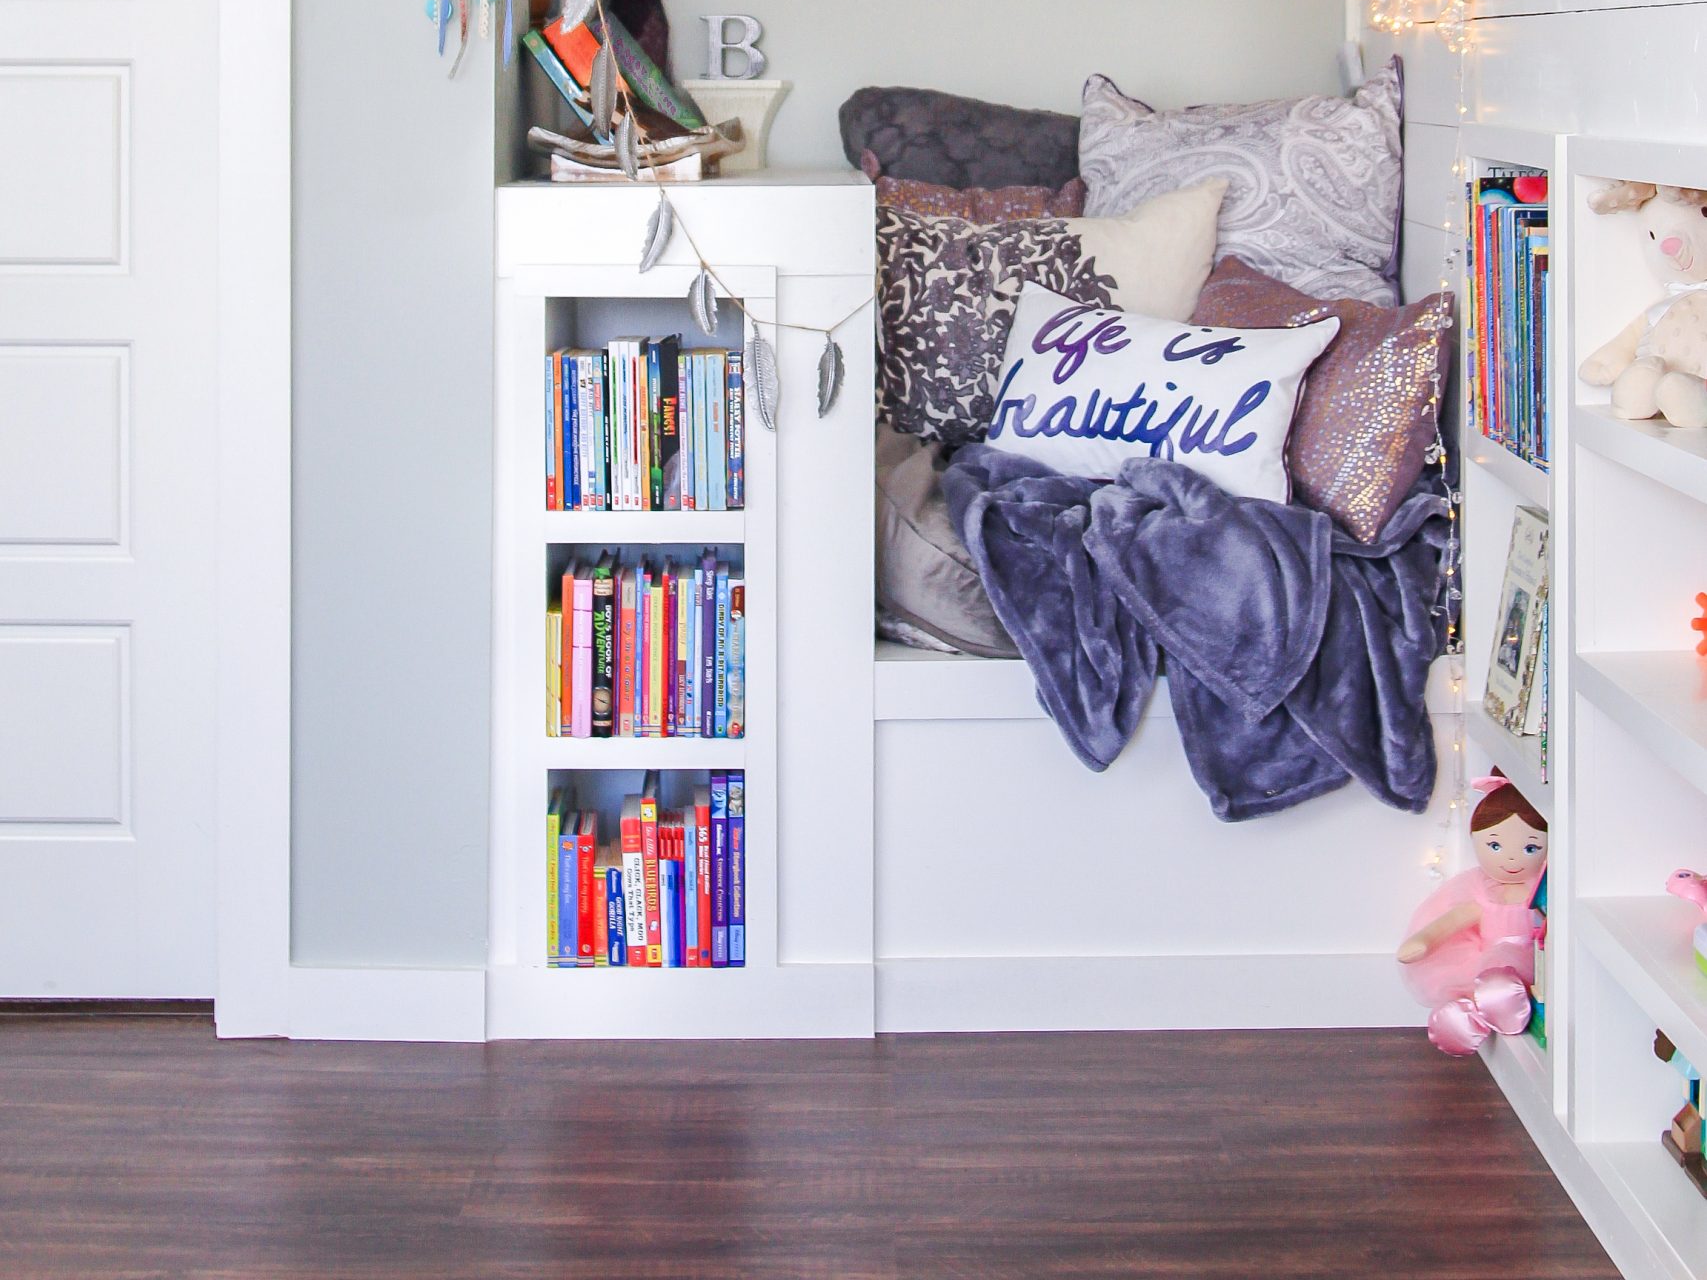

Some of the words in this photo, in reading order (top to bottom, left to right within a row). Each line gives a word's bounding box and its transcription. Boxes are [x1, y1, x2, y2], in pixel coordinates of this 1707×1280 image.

[700, 14, 767, 80] B
[1032, 304, 1132, 385] life
[1164, 328, 1246, 365] is
[662, 397, 678, 436] FANGS!
[987, 358, 1272, 462] beautiful
[594, 611, 608, 674] ADVENTURE
